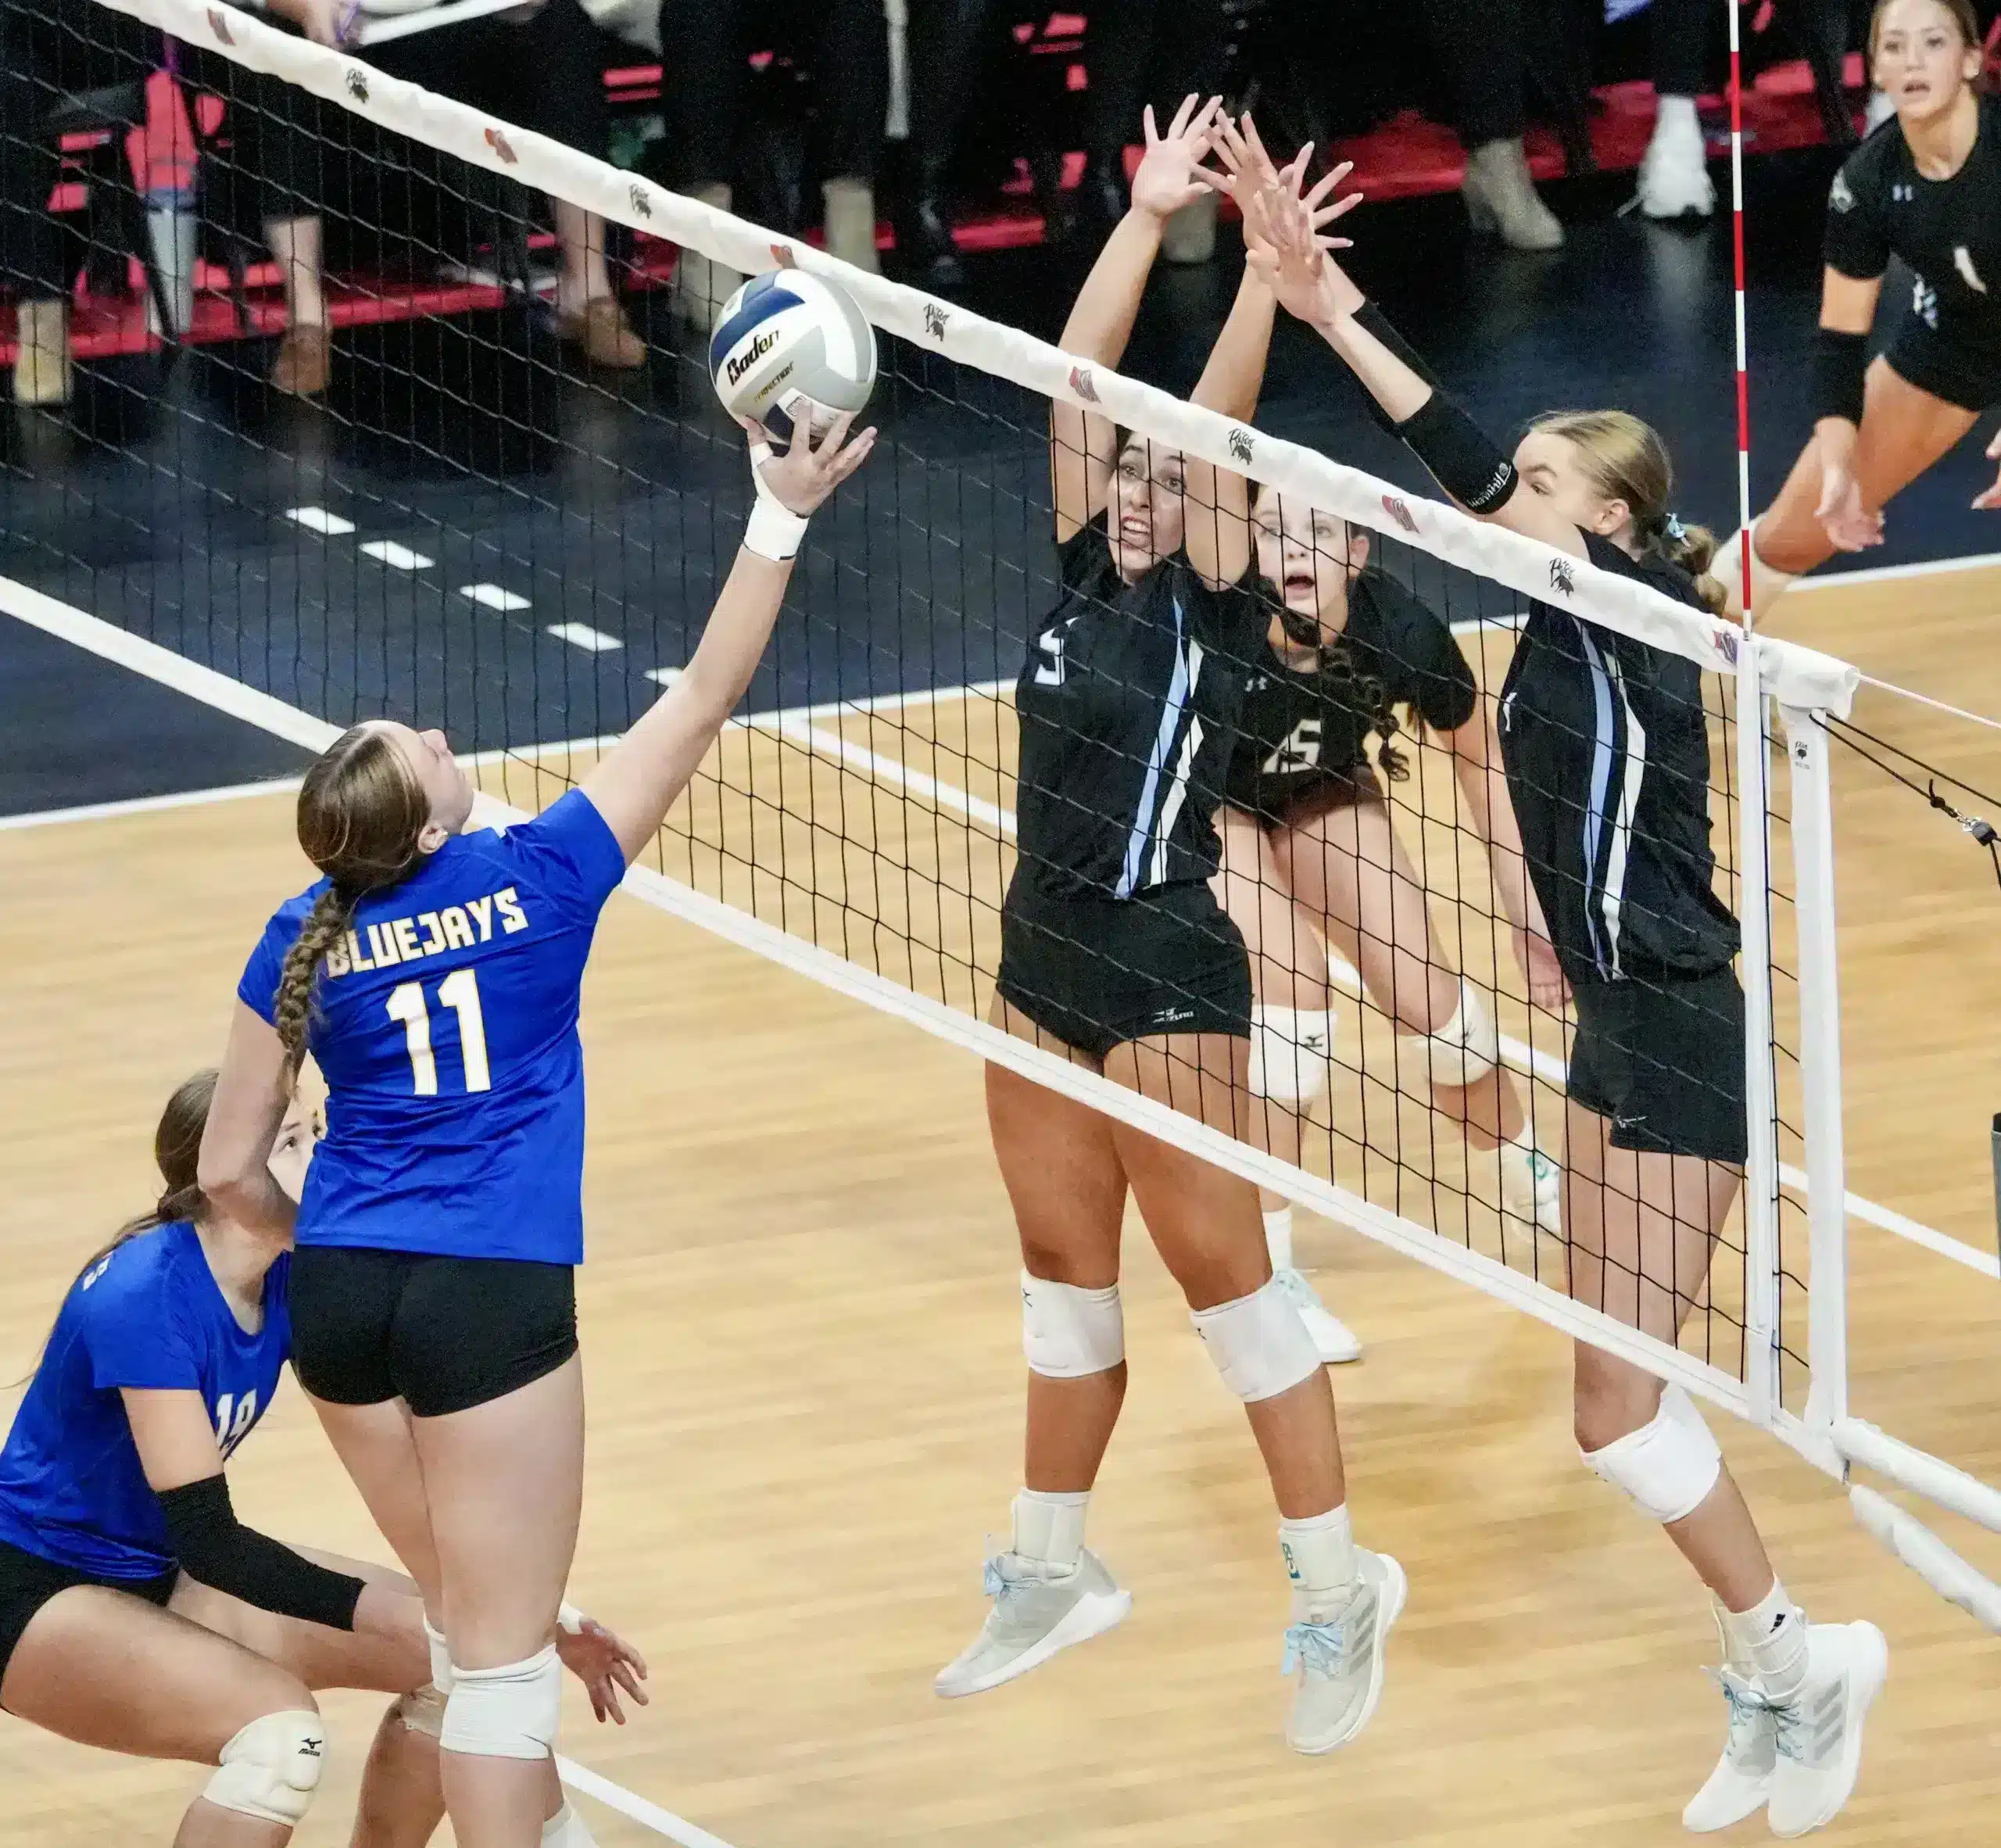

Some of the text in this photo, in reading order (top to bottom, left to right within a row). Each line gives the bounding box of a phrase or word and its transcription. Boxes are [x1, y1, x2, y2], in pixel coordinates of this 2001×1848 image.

[727, 329, 779, 386] Baden
[326, 886, 529, 978] BLUEJAYS
[385, 969, 491, 1096] 11
